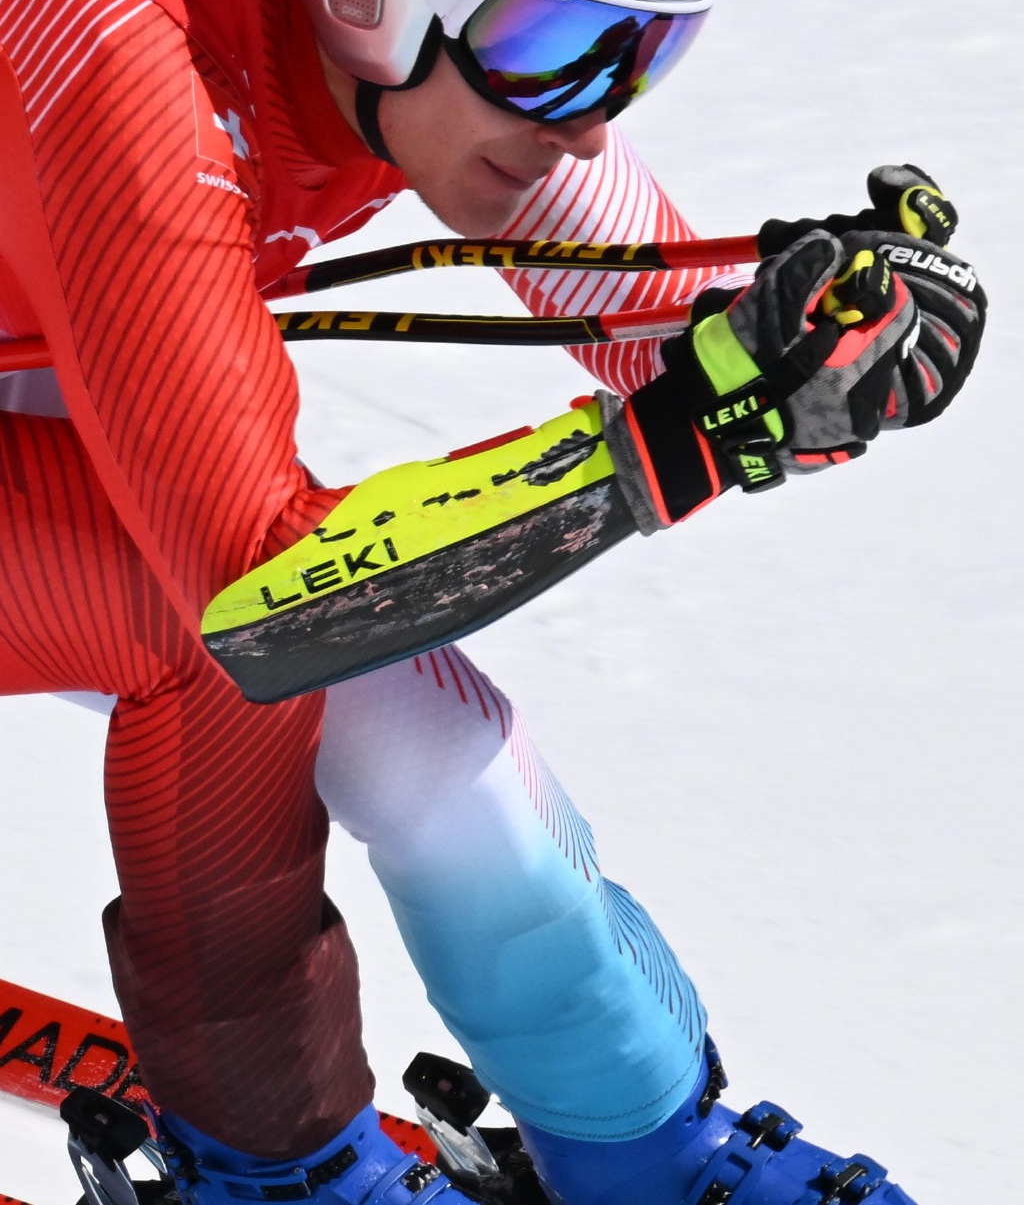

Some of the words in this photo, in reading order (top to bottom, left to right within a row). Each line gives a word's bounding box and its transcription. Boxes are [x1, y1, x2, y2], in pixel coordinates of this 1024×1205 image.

[919, 195, 951, 228] LEKI
[878, 244, 976, 292] reusch
[703, 395, 758, 430] LEKI
[739, 454, 773, 483] EKI
[260, 537, 400, 611] LEKI
